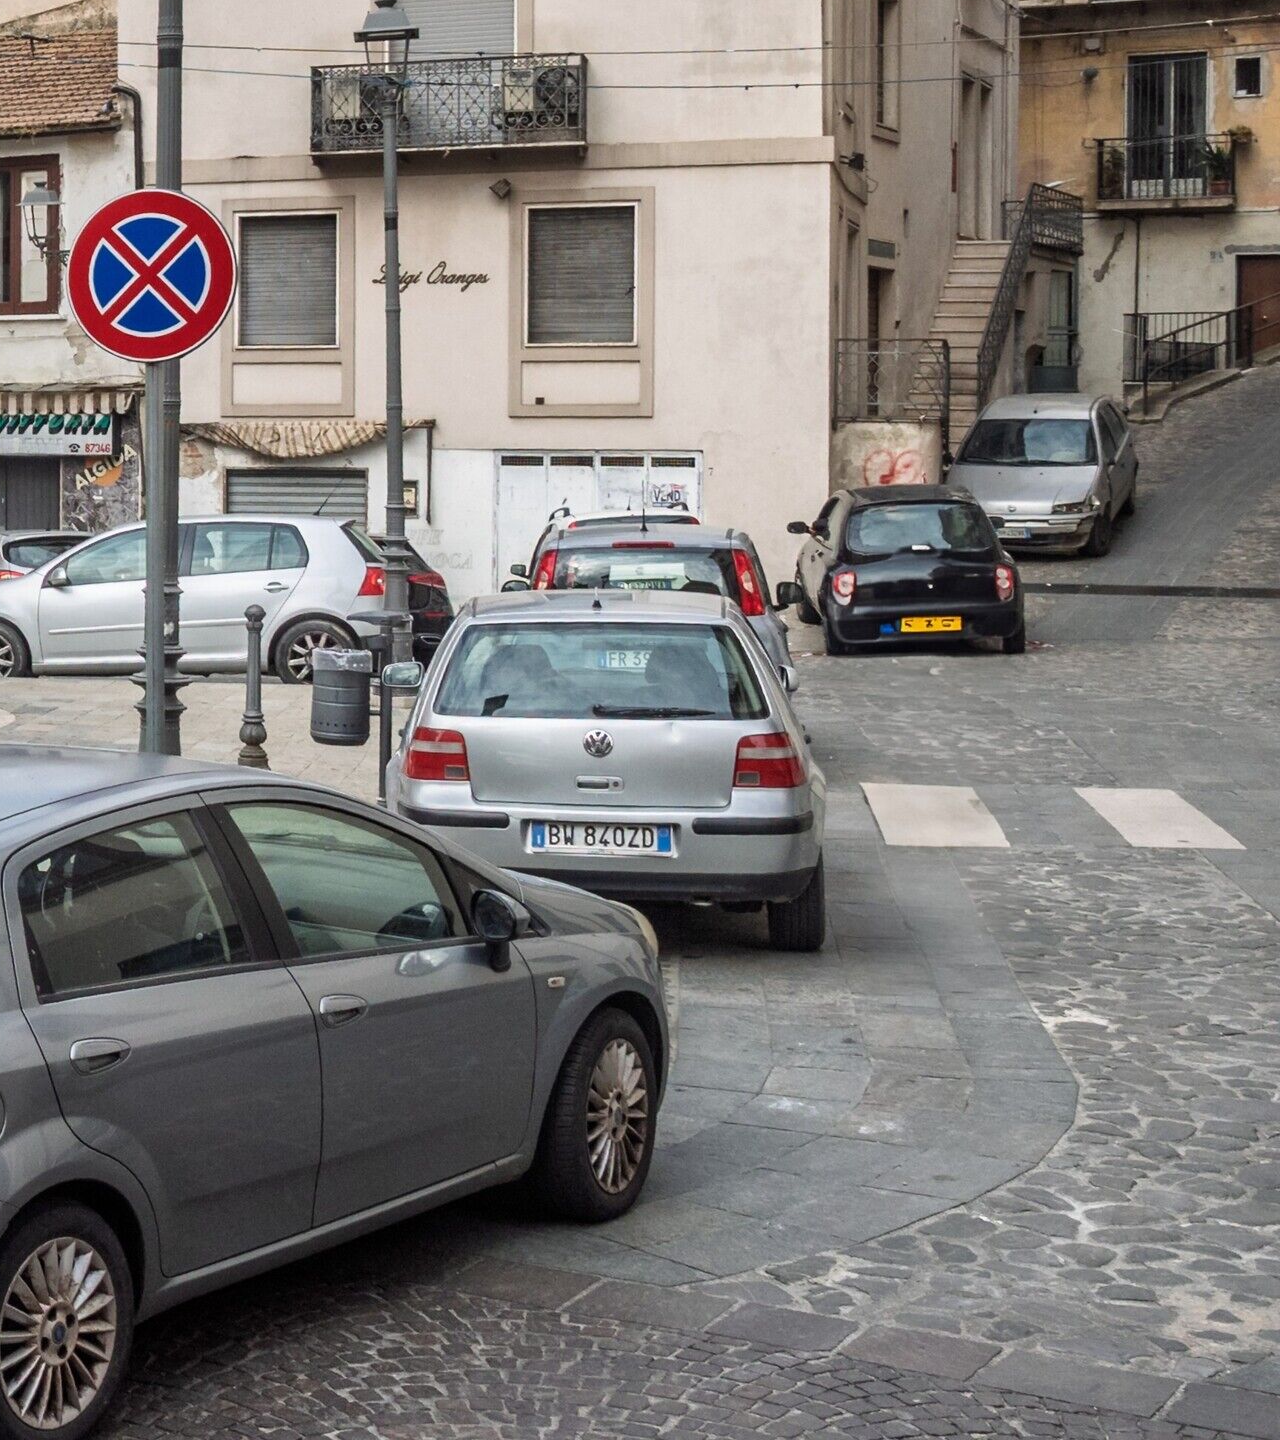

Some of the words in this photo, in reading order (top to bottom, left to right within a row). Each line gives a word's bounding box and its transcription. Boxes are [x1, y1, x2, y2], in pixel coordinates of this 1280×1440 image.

[84, 443, 111, 454] 87346
[608, 651, 627, 667] FR
[548, 823, 575, 846] BW
[583, 825, 655, 849] 840ZD
